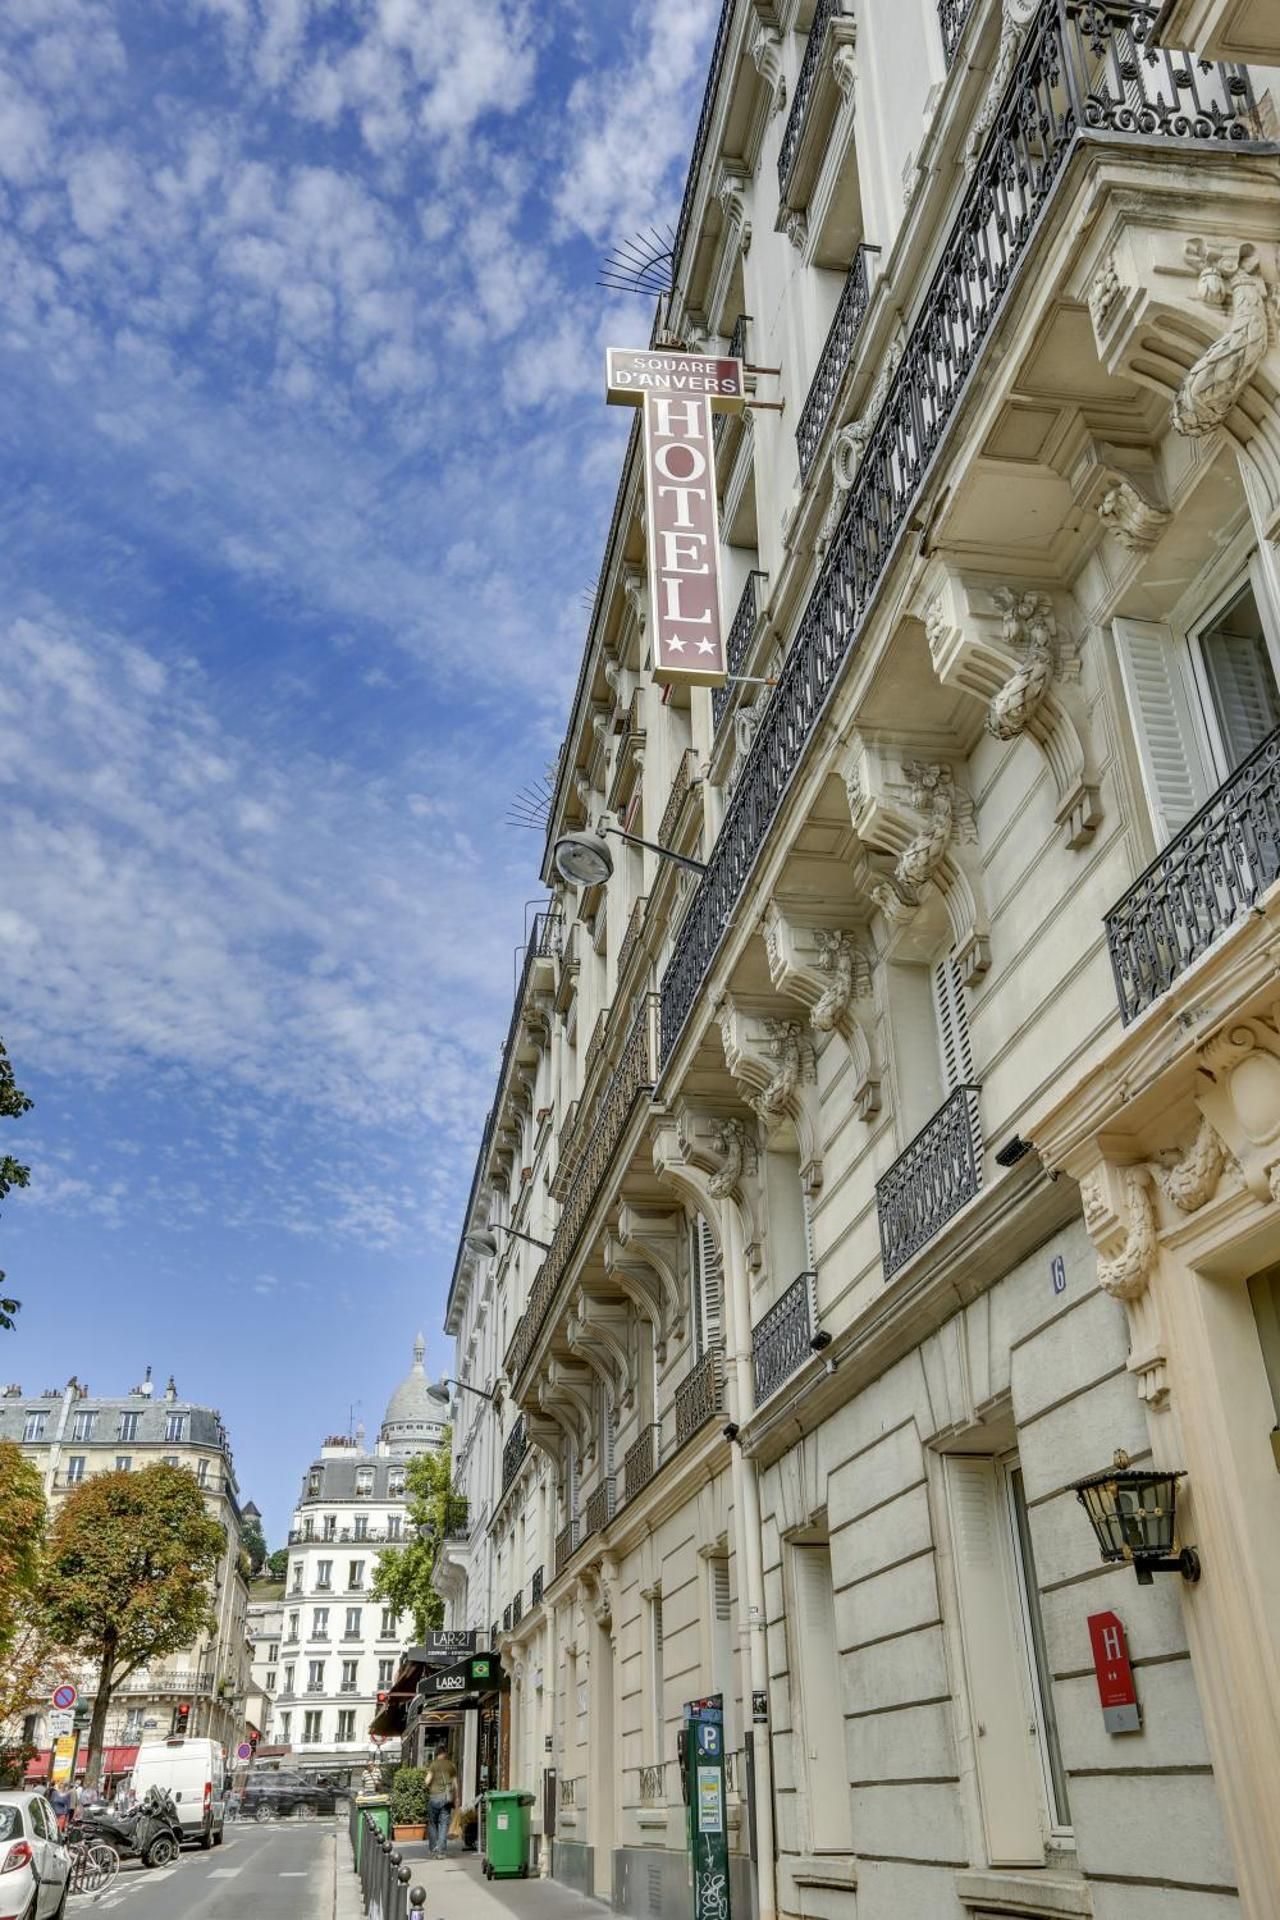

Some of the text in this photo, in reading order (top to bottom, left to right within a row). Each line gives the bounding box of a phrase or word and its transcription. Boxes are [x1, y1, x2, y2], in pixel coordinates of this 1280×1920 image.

[634, 358, 717, 374] SQUARE
[616, 370, 736, 393] D'ANVERS
[653, 398, 711, 624] HOTEL
[1054, 1258, 1064, 1290] 6
[1102, 1627, 1122, 1660] H
[704, 1727, 716, 1749] P
